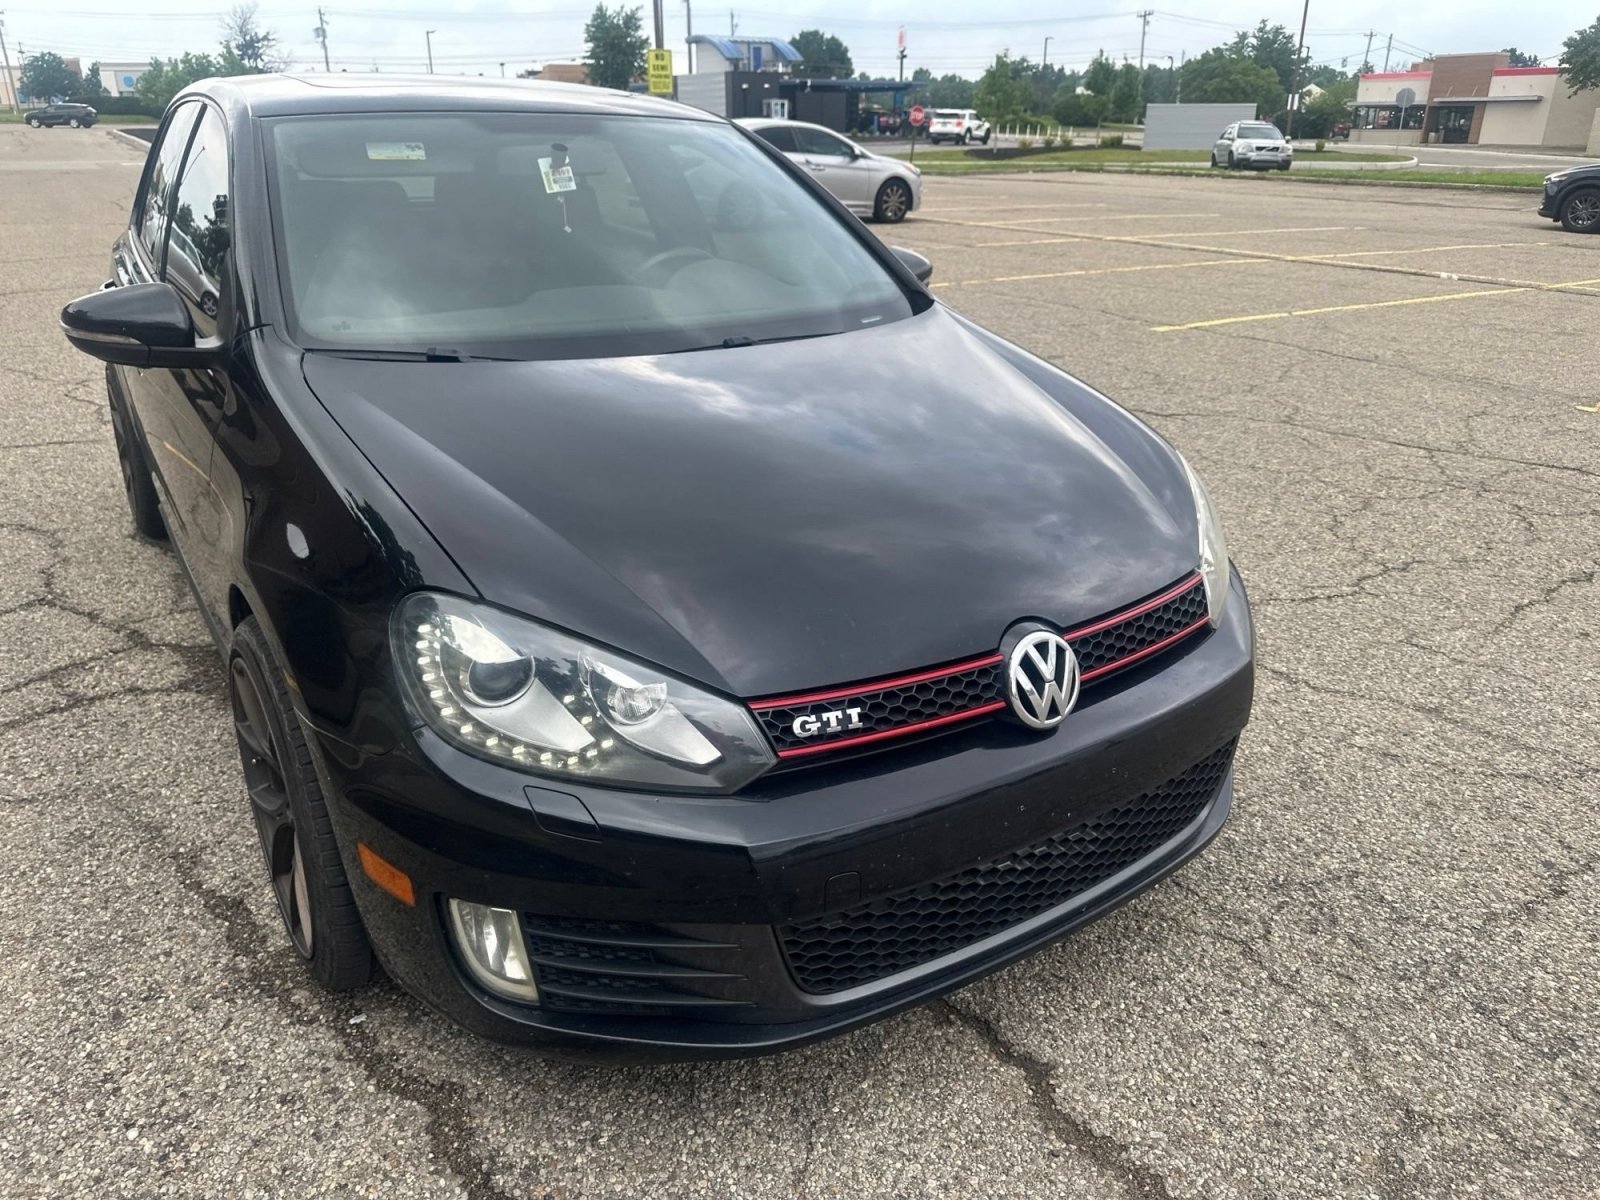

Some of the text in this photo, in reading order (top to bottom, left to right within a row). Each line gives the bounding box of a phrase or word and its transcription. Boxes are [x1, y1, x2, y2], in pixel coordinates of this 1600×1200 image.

[655, 53, 665, 61] NO
[652, 64, 668, 72] SEMI
[911, 112, 924, 120] STOP
[792, 707, 864, 738] GTI
